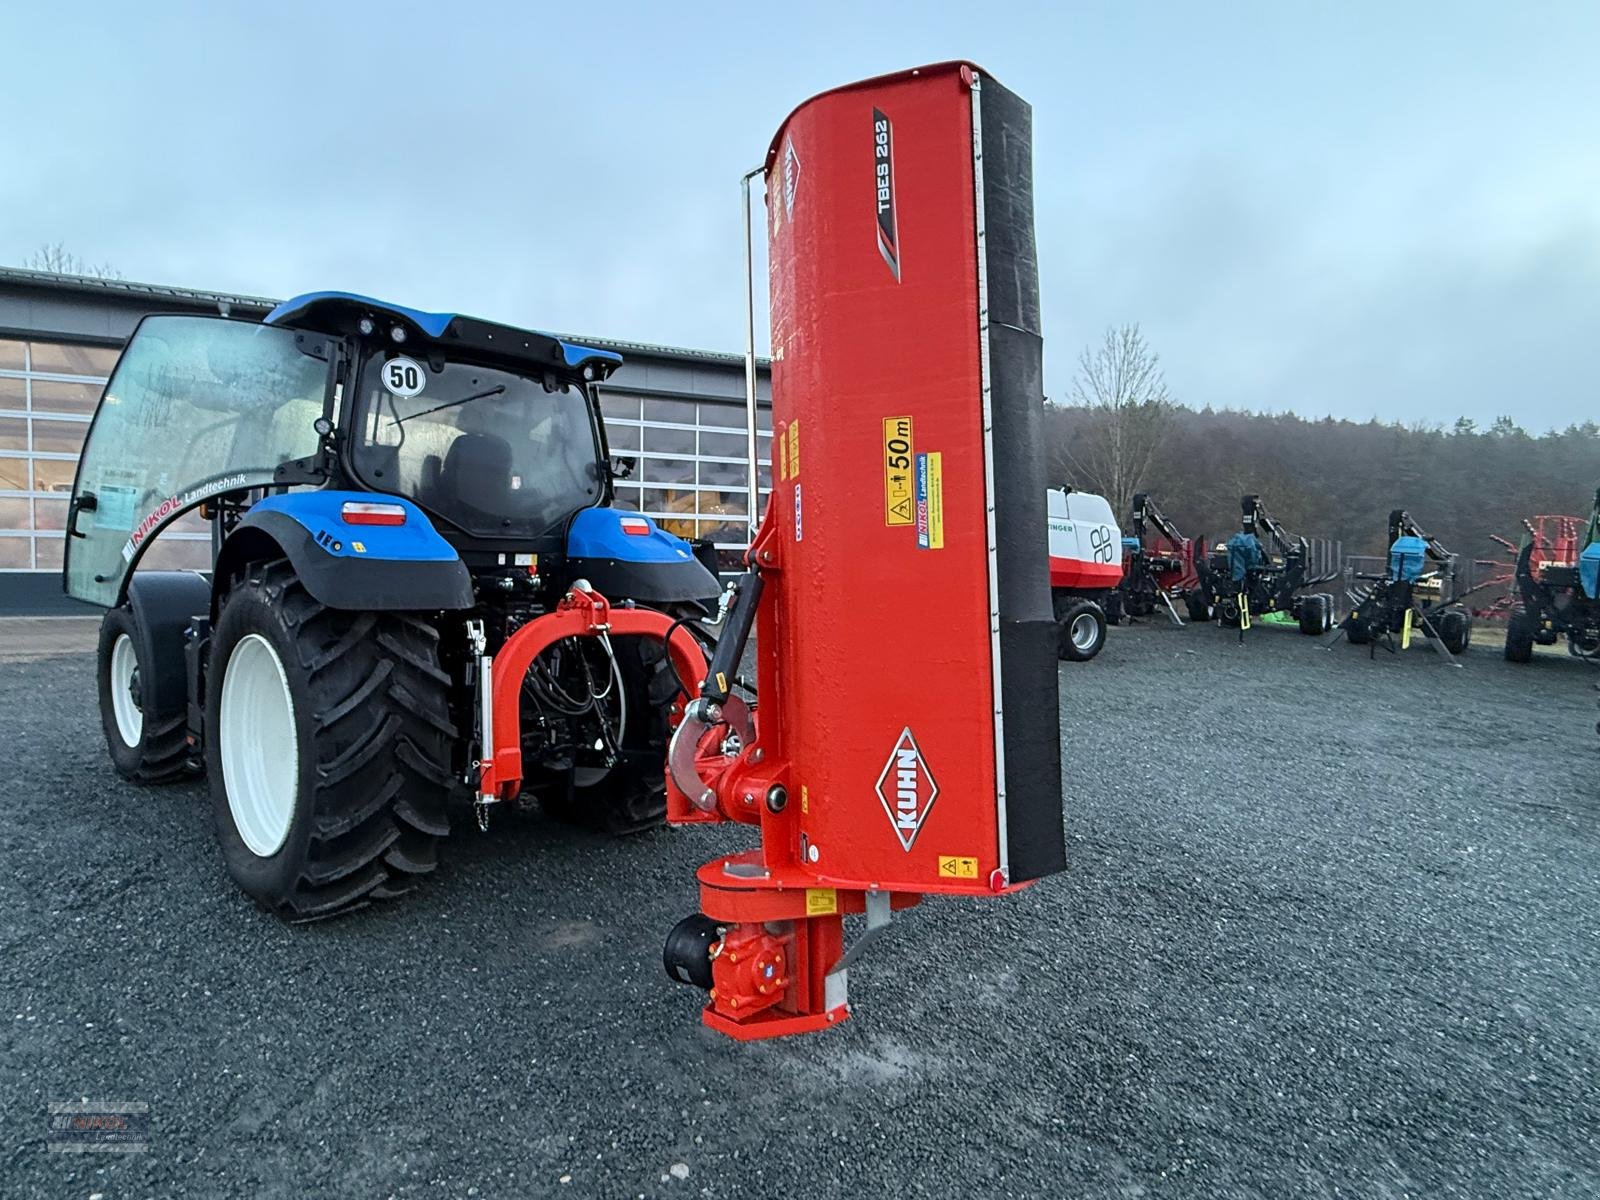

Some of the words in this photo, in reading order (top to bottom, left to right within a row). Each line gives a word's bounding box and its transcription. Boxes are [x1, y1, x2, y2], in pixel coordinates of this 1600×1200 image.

[875, 120, 888, 158] 262
[877, 163, 890, 214] TBES
[390, 365, 418, 390] 50
[896, 421, 909, 437] m
[888, 439, 910, 470] 50
[132, 495, 183, 545] NIKOL
[184, 473, 247, 503] Landtechnik
[918, 499, 928, 534] NIKOL
[897, 749, 917, 829] KUHN
